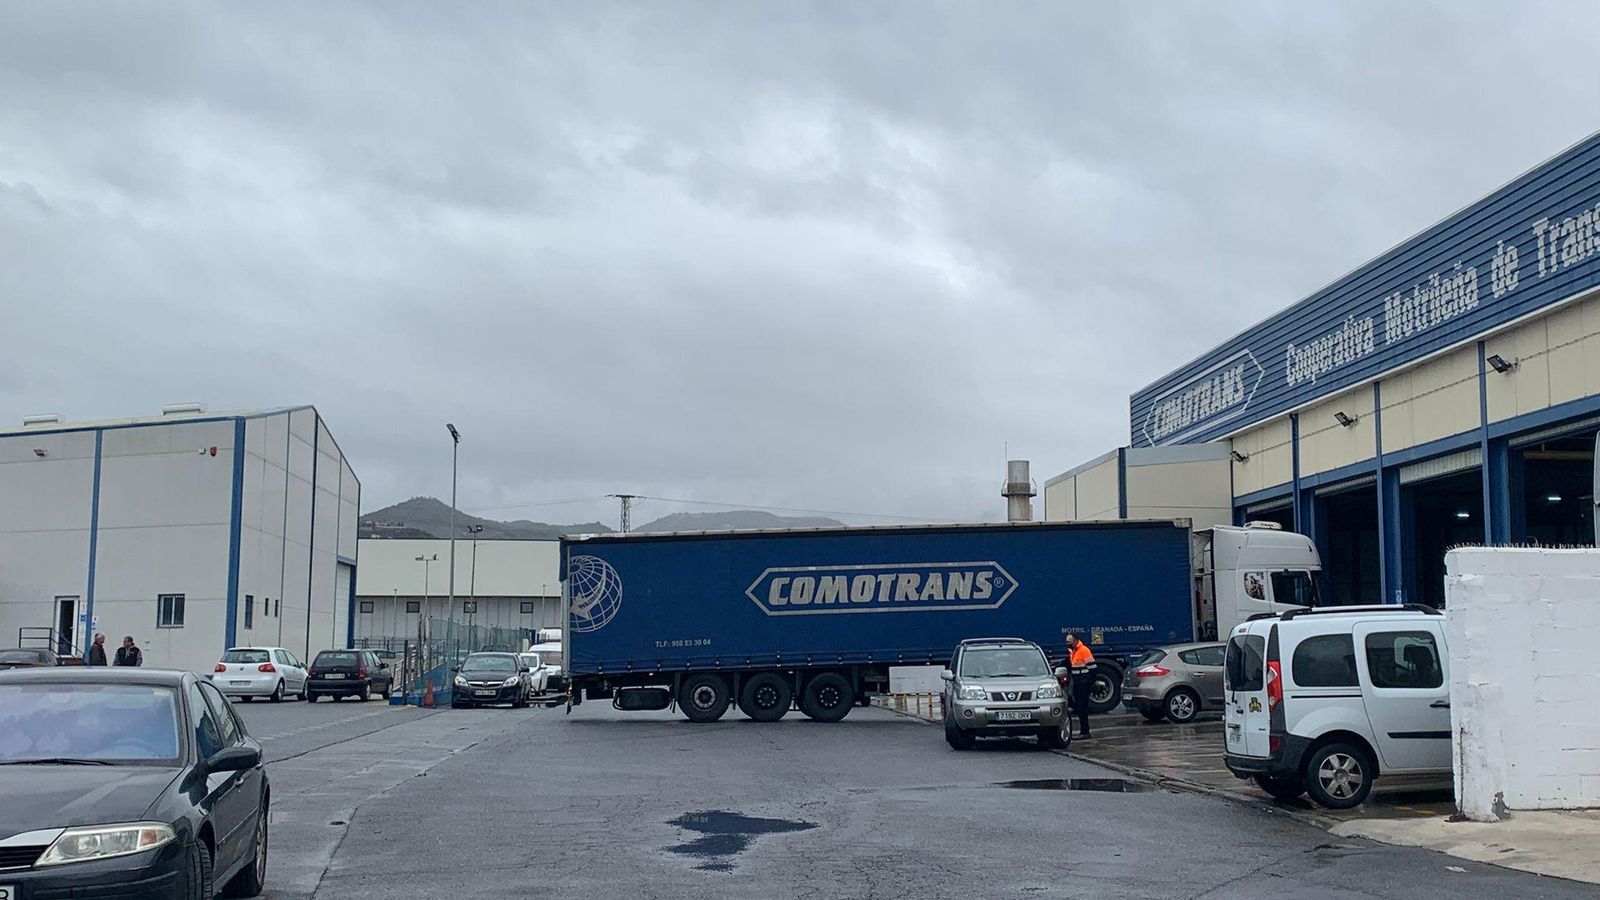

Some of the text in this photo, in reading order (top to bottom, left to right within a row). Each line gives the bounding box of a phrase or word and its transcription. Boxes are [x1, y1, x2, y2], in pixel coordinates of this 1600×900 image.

[1286, 315, 1376, 386] Cooperativa
[1384, 260, 1480, 345] Motrileña
[1491, 241, 1520, 299] de
[1152, 363, 1246, 440] COMOTRANS
[769, 570, 994, 606] COMOTRANS
[1061, 627, 1085, 635] MOTRIL
[1128, 624, 1154, 632] ESPAÑA
